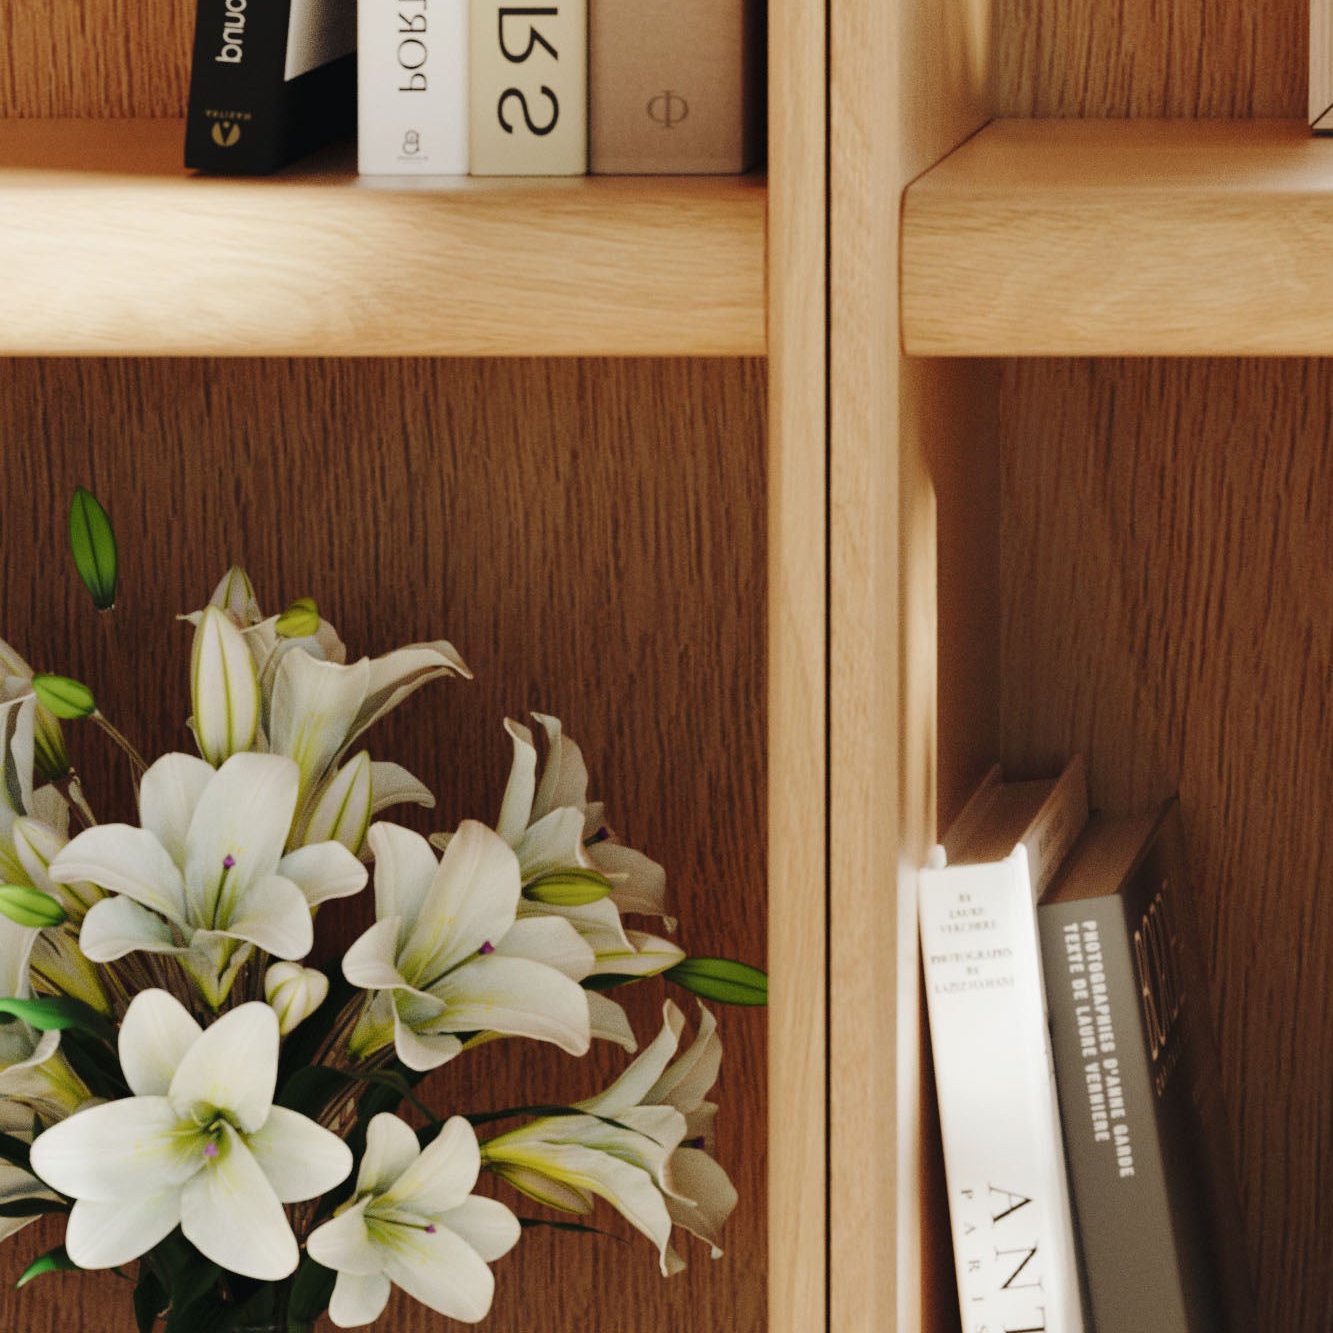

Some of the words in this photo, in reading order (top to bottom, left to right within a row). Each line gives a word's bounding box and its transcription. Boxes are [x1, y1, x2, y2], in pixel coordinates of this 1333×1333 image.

[1063, 923, 1086, 974] TEXTE
[1071, 978, 1088, 1001] DE
[1074, 1006, 1097, 1057] LAURE
[1081, 920, 1116, 1053] PHOTOGRAPHIES
[1112, 1124, 1135, 1178] GARDE
